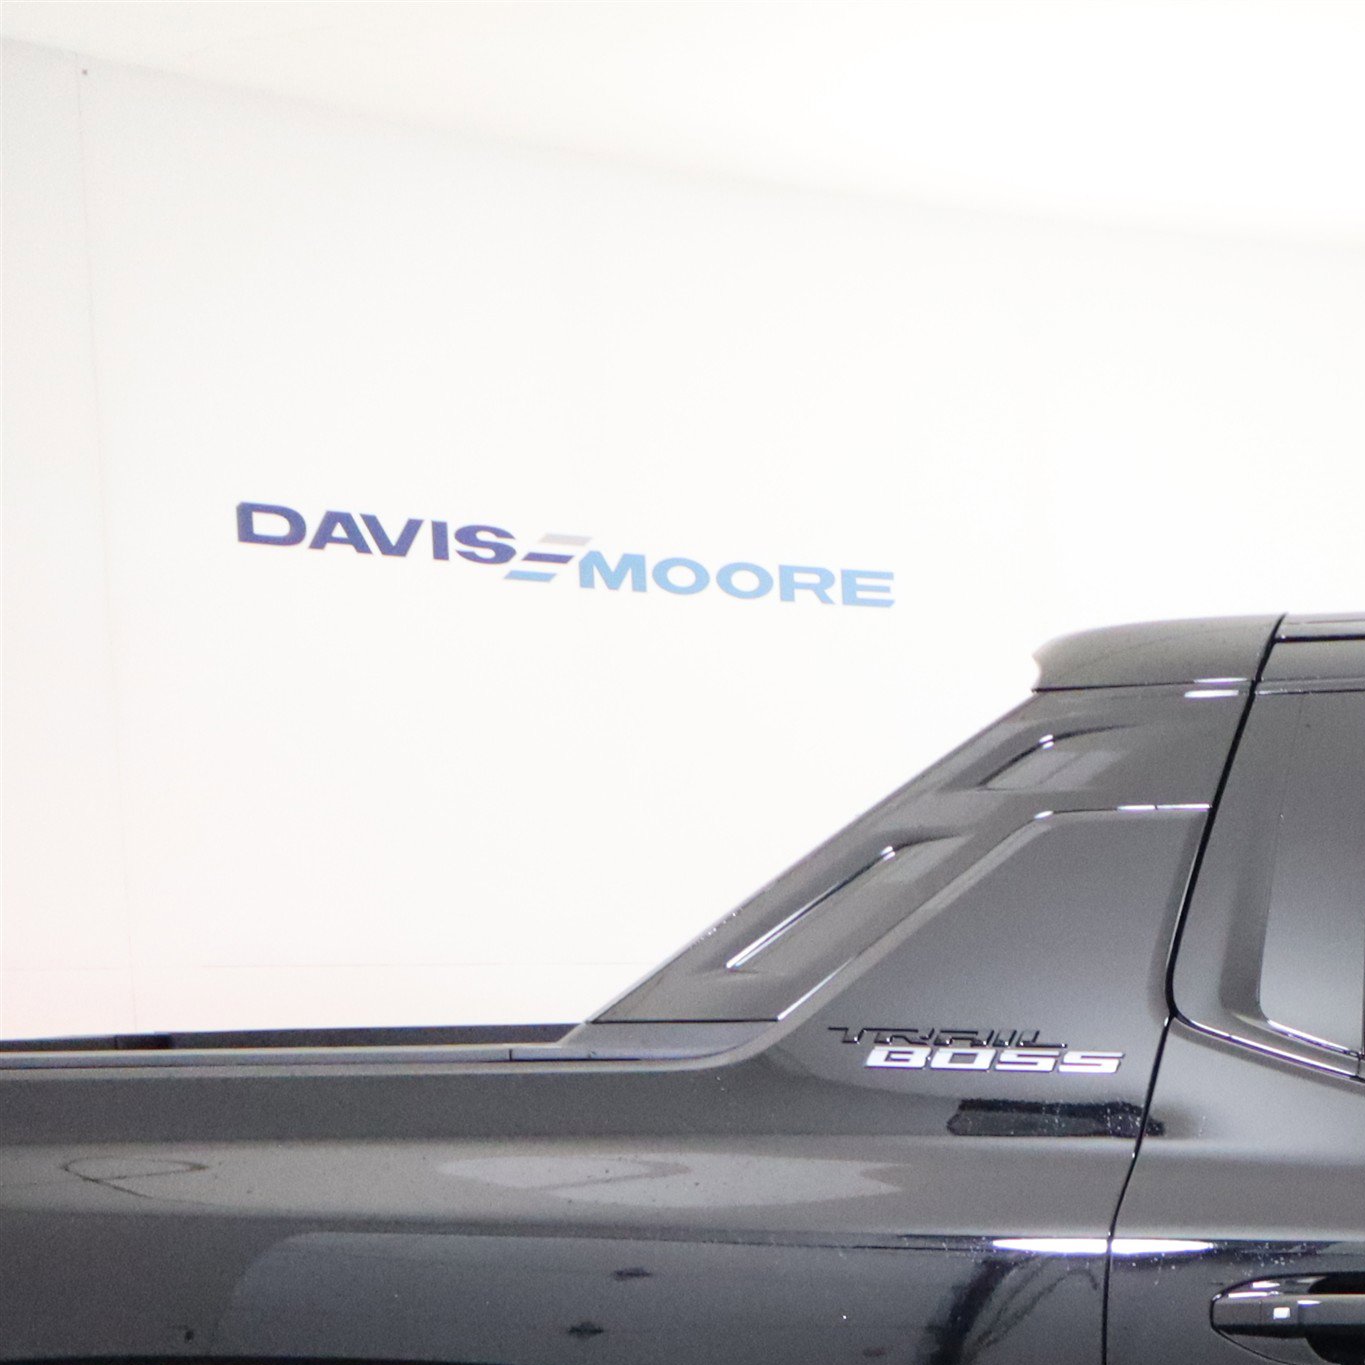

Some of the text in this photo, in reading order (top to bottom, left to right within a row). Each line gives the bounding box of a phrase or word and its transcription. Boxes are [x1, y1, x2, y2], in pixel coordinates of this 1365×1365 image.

[236, 501, 896, 608] DAVIS MOORE
[828, 1027, 1067, 1048] TRAIL
[865, 1046, 1124, 1074] BOSS
